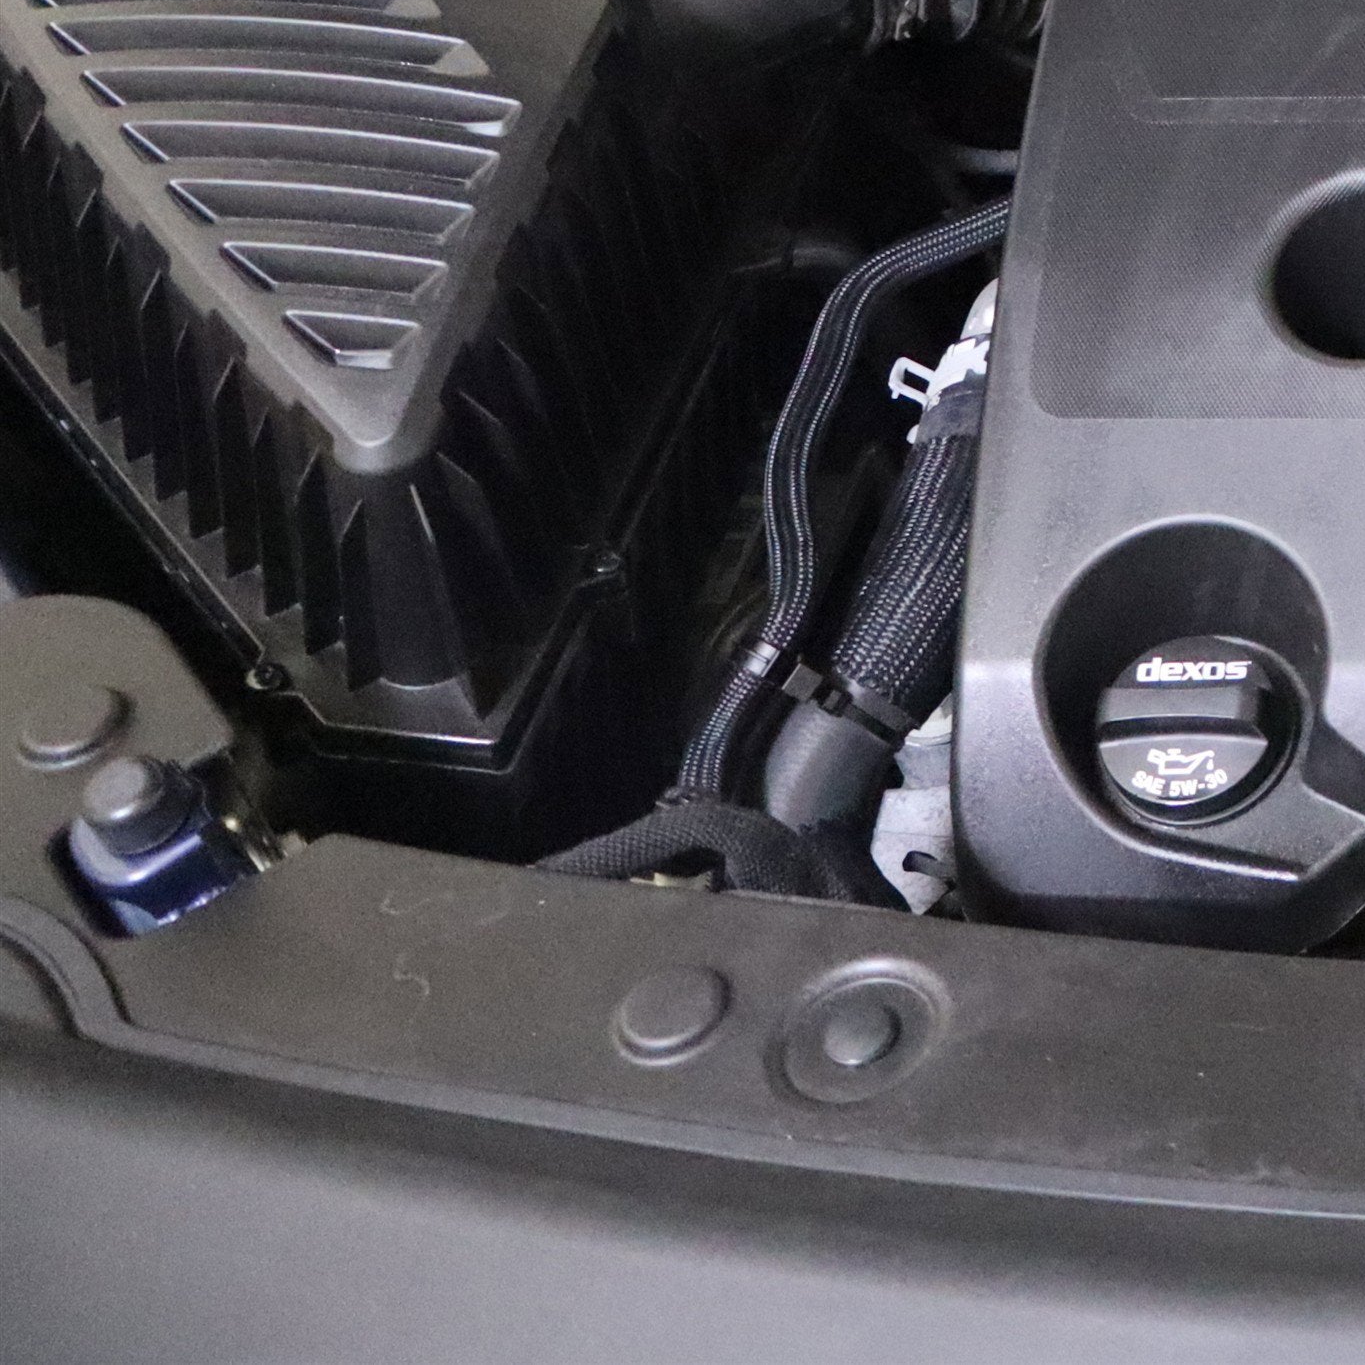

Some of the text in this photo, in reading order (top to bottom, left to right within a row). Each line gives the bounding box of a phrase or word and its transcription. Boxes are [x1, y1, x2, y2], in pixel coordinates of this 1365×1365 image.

[1136, 657, 1249, 683] dexos
[1131, 768, 1228, 796] SAE 5W-30
